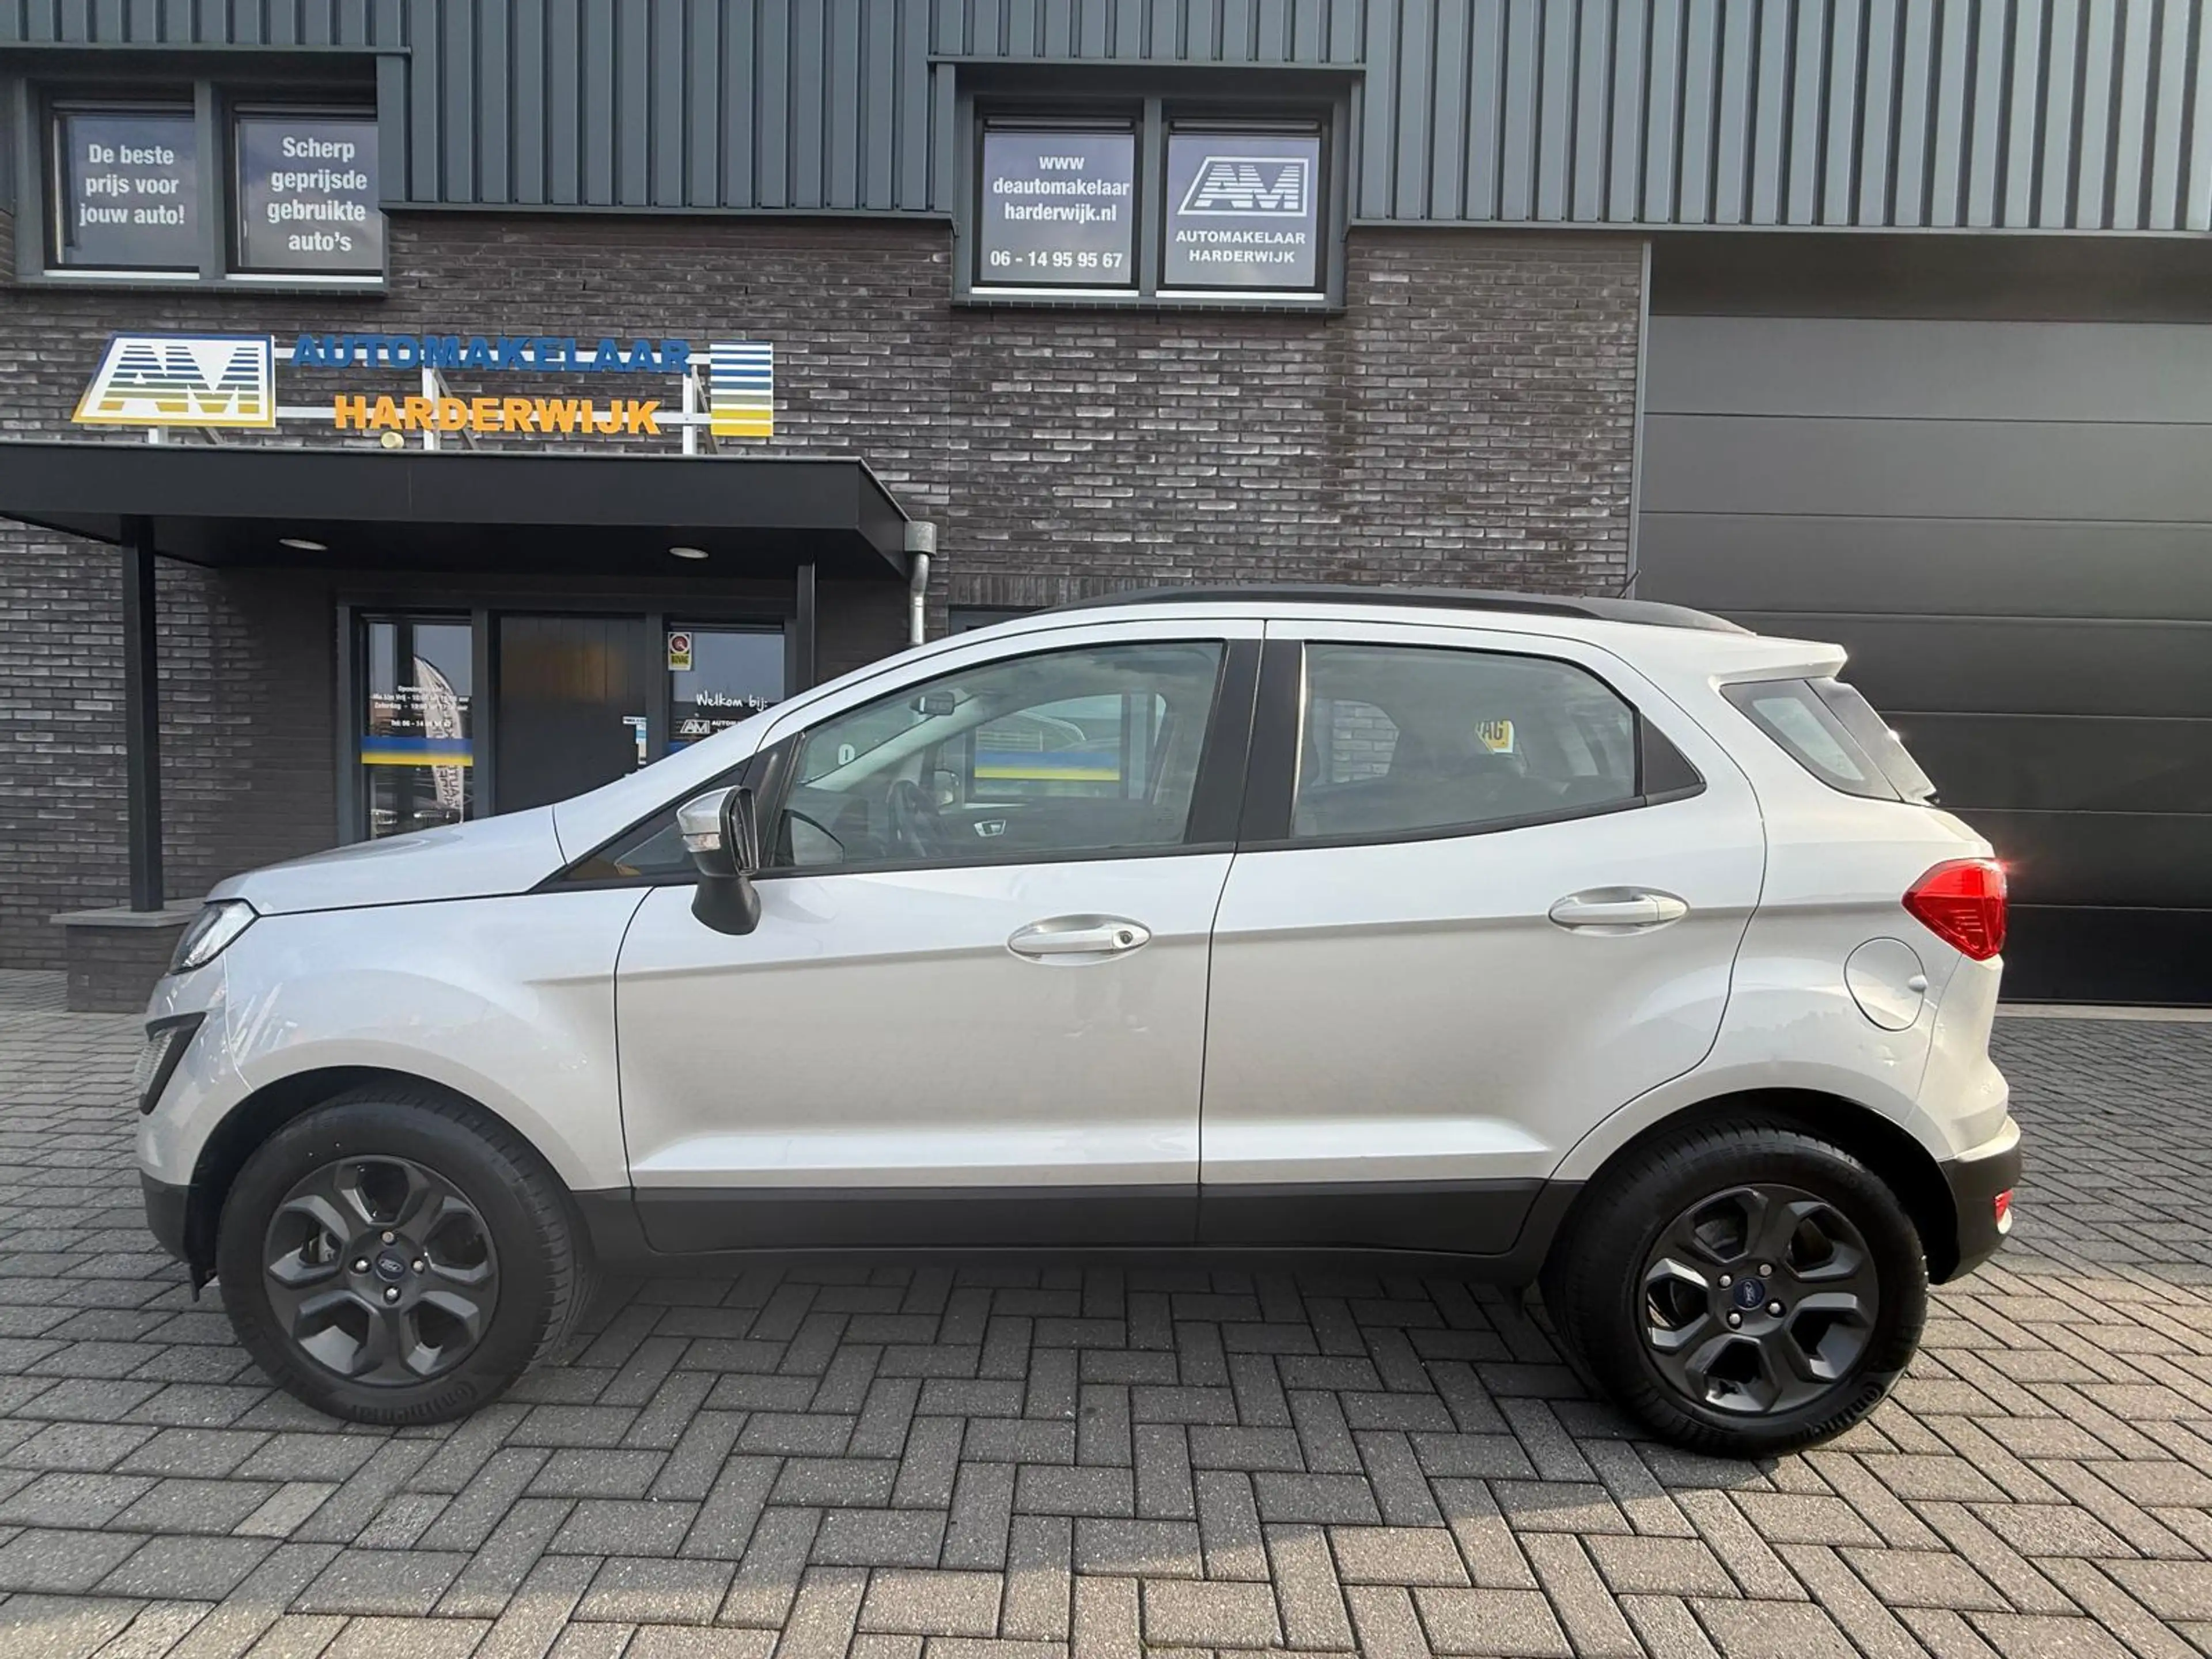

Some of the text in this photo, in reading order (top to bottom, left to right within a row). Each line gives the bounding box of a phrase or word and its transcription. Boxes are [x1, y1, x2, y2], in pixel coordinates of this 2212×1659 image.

[89, 145, 174, 165] De beste
[282, 137, 355, 162] Scherp
[1039, 156, 1085, 171] www
[85, 176, 179, 197] prijs voor
[271, 170, 367, 194] geprijsde
[993, 179, 1130, 197] deautomakelaar
[1194, 164, 1300, 209] AM
[79, 206, 185, 226] jouw auto!
[267, 200, 366, 224] gebruikte
[1004, 203, 1116, 224] harderwijk.nl
[289, 232, 351, 252] auto's
[1176, 230, 1306, 245] AUTOMAKELAAR
[990, 251, 1009, 267] 06
[1028, 251, 1047, 267] 14
[1052, 252, 1071, 267] 95
[1077, 252, 1097, 268] 95
[1102, 252, 1122, 268] 67
[1189, 249, 1295, 264] HARDERWIJK
[290, 335, 692, 374] AUTOMAKELAAR
[99, 345, 262, 413] AM
[334, 395, 661, 435] HARDERWIJK
[696, 690, 768, 711] Welkom bij:
